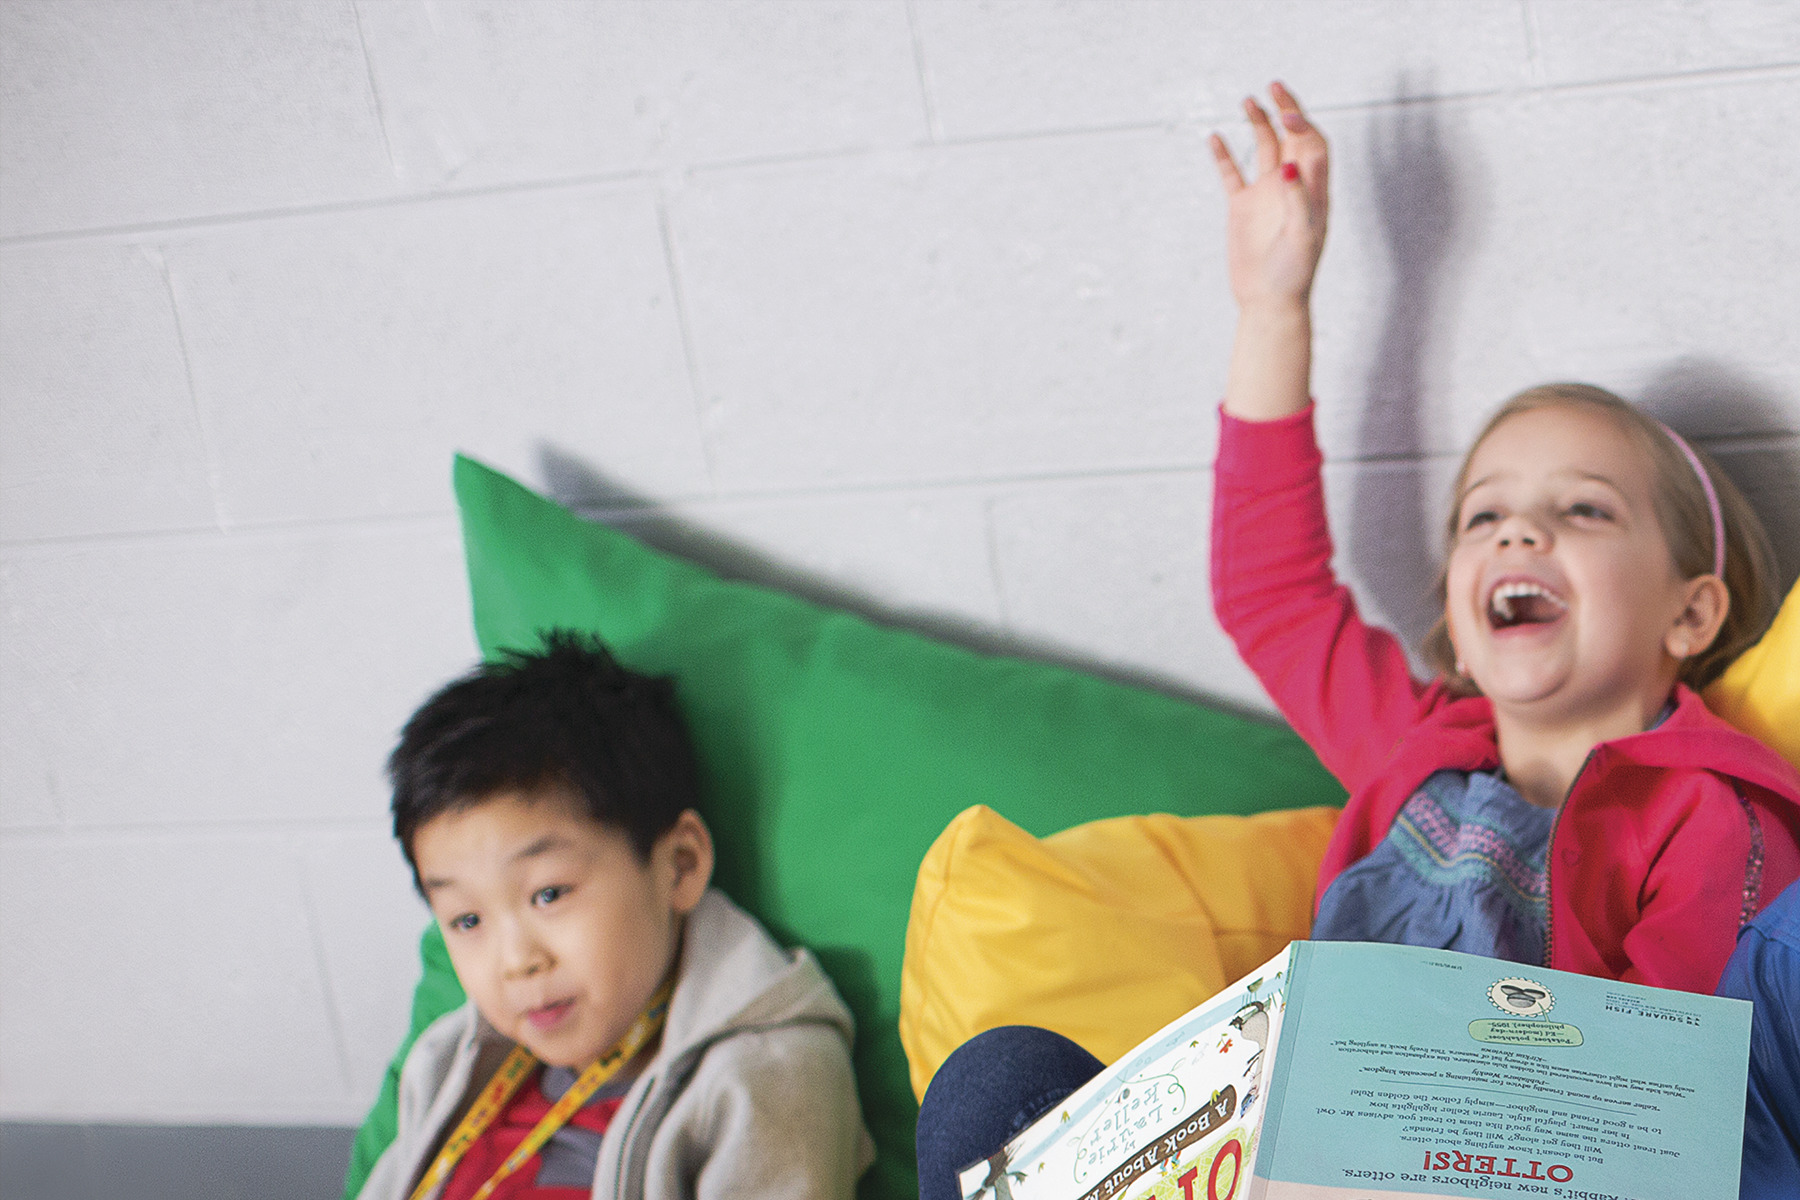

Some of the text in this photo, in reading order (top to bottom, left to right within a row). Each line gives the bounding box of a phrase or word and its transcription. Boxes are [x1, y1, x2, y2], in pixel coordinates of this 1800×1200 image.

[1605, 1005, 1631, 1014] FISH
[1636, 1010, 1684, 1023] SQUARE
[1350, 1089, 1374, 1098] Rule!
[1377, 1091, 1410, 1100] Golden
[1430, 1095, 1461, 1104] follow
[1214, 1098, 1230, 1118] A
[1369, 1101, 1389, 1109] how
[1391, 1102, 1437, 1113] highlights
[1089, 1082, 1160, 1146] Keller
[1338, 1109, 1354, 1117] Mr.
[1357, 1111, 1394, 1120] advises
[1440, 1107, 1470, 1115] Keller
[1472, 1110, 1503, 1119] Laurie
[1419, 1115, 1443, 1123] treat
[1459, 1119, 1482, 1127] them
[1534, 1117, 1567, 1127] playful
[1570, 1113, 1600, 1124] friend
[1485, 1122, 1503, 1130] like
[1602, 1119, 1627, 1128] good
[1164, 1112, 1212, 1154] Book
[1402, 1125, 1444, 1134] friends?
[1447, 1128, 1459, 1136] be
[1462, 1128, 1483, 1138] they
[1534, 1125, 1552, 1134] way
[1601, 1129, 1618, 1137] her
[1636, 1125, 1648, 1133] be
[1651, 1127, 1661, 1135] to
[1087, 1104, 1163, 1166] Laurie
[1485, 1132, 1504, 1140] Will
[1507, 1133, 1539, 1144] along?
[1555, 1130, 1579, 1138] same
[1399, 1135, 1432, 1143] otters.
[1435, 1138, 1462, 1146] about
[1464, 1138, 1504, 1149] anything
[1582, 1135, 1597, 1143] the
[1600, 1138, 1630, 1148] otters
[1123, 1140, 1136, 1154] by
[1560, 1139, 1581, 1150] they
[1633, 1144, 1656, 1154] treat
[1507, 1145, 1533, 1154] know
[1583, 1145, 1603, 1154] Will
[1659, 1149, 1680, 1158] Just
[1573, 1153, 1585, 1161] he
[1588, 1156, 1603, 1164] But
[1423, 1150, 1574, 1183] OTTERS!
[1104, 1148, 1160, 1195] About
[1342, 1168, 1395, 1181] otters.
[1400, 1173, 1427, 1182] are
[1432, 1175, 1512, 1190] neighbors
[1517, 1183, 1548, 1194] new
